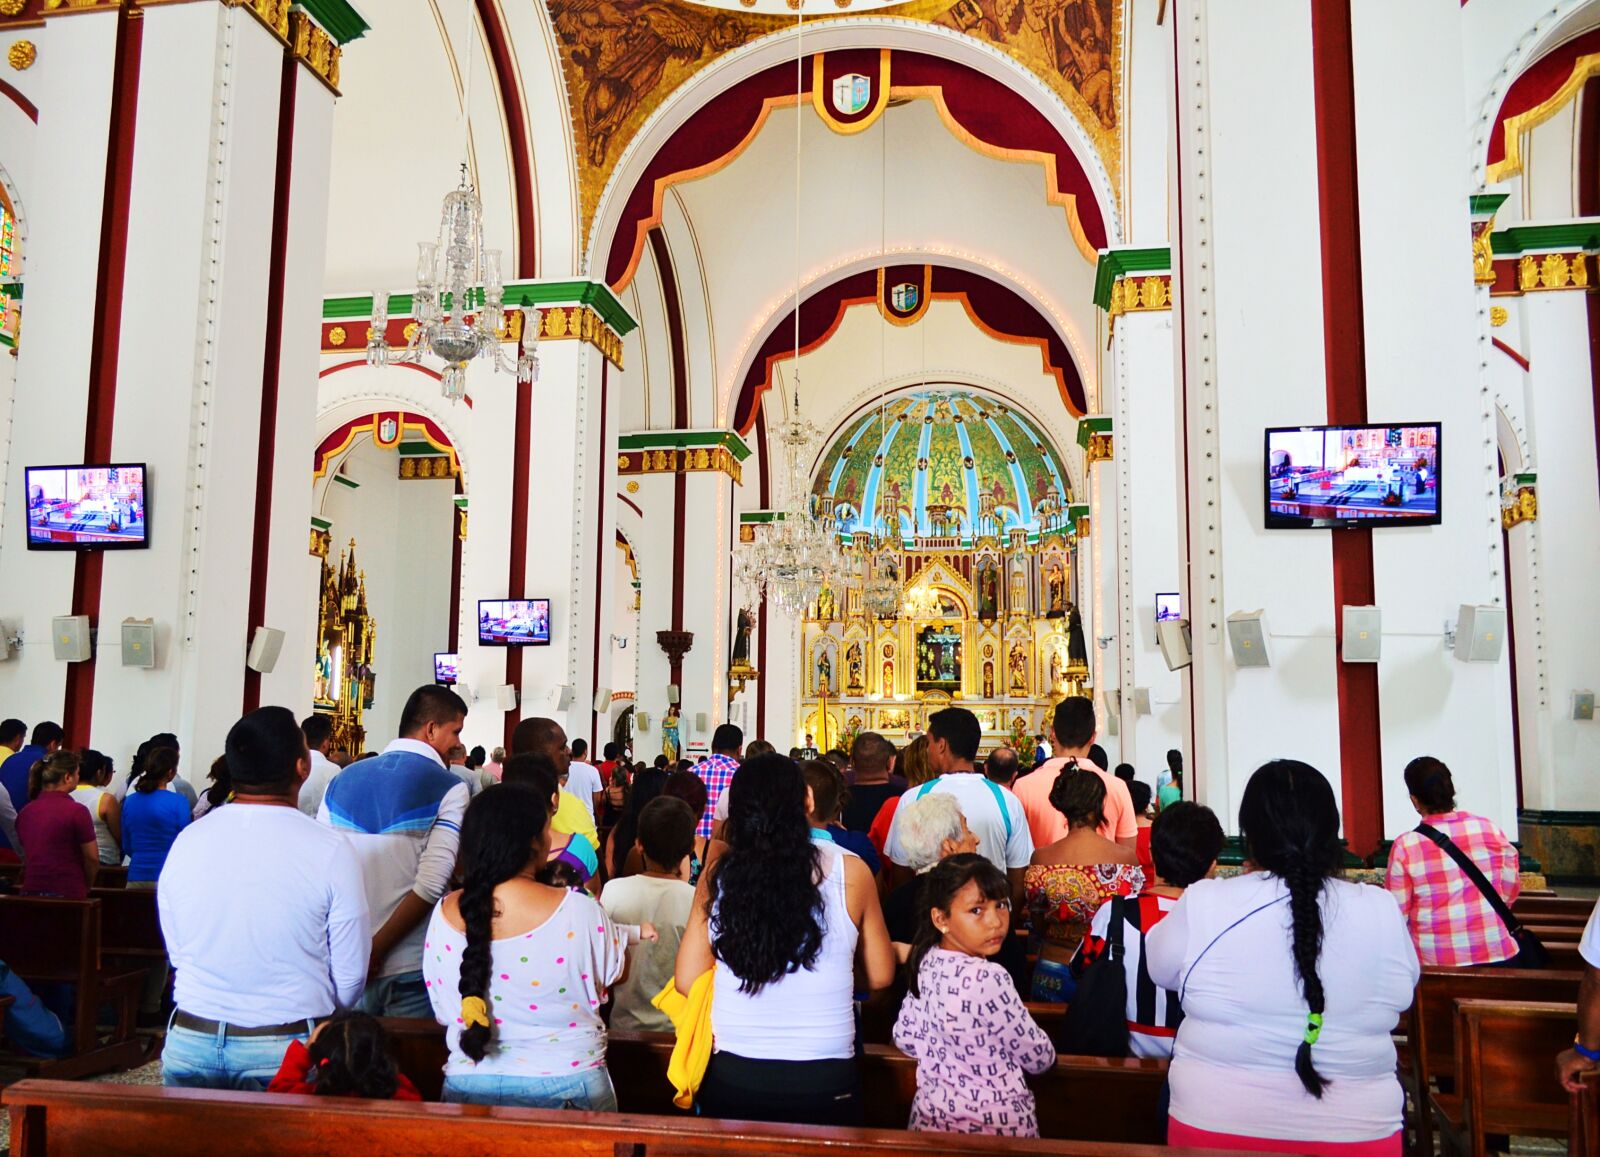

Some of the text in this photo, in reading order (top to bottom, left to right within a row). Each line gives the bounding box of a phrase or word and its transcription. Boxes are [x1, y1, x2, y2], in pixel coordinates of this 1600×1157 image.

[961, 1000, 971, 1013] H
[985, 999, 999, 1014] H
[970, 1064, 982, 1076] H
[983, 1111, 994, 1125] H
[998, 1112, 1008, 1126] U
